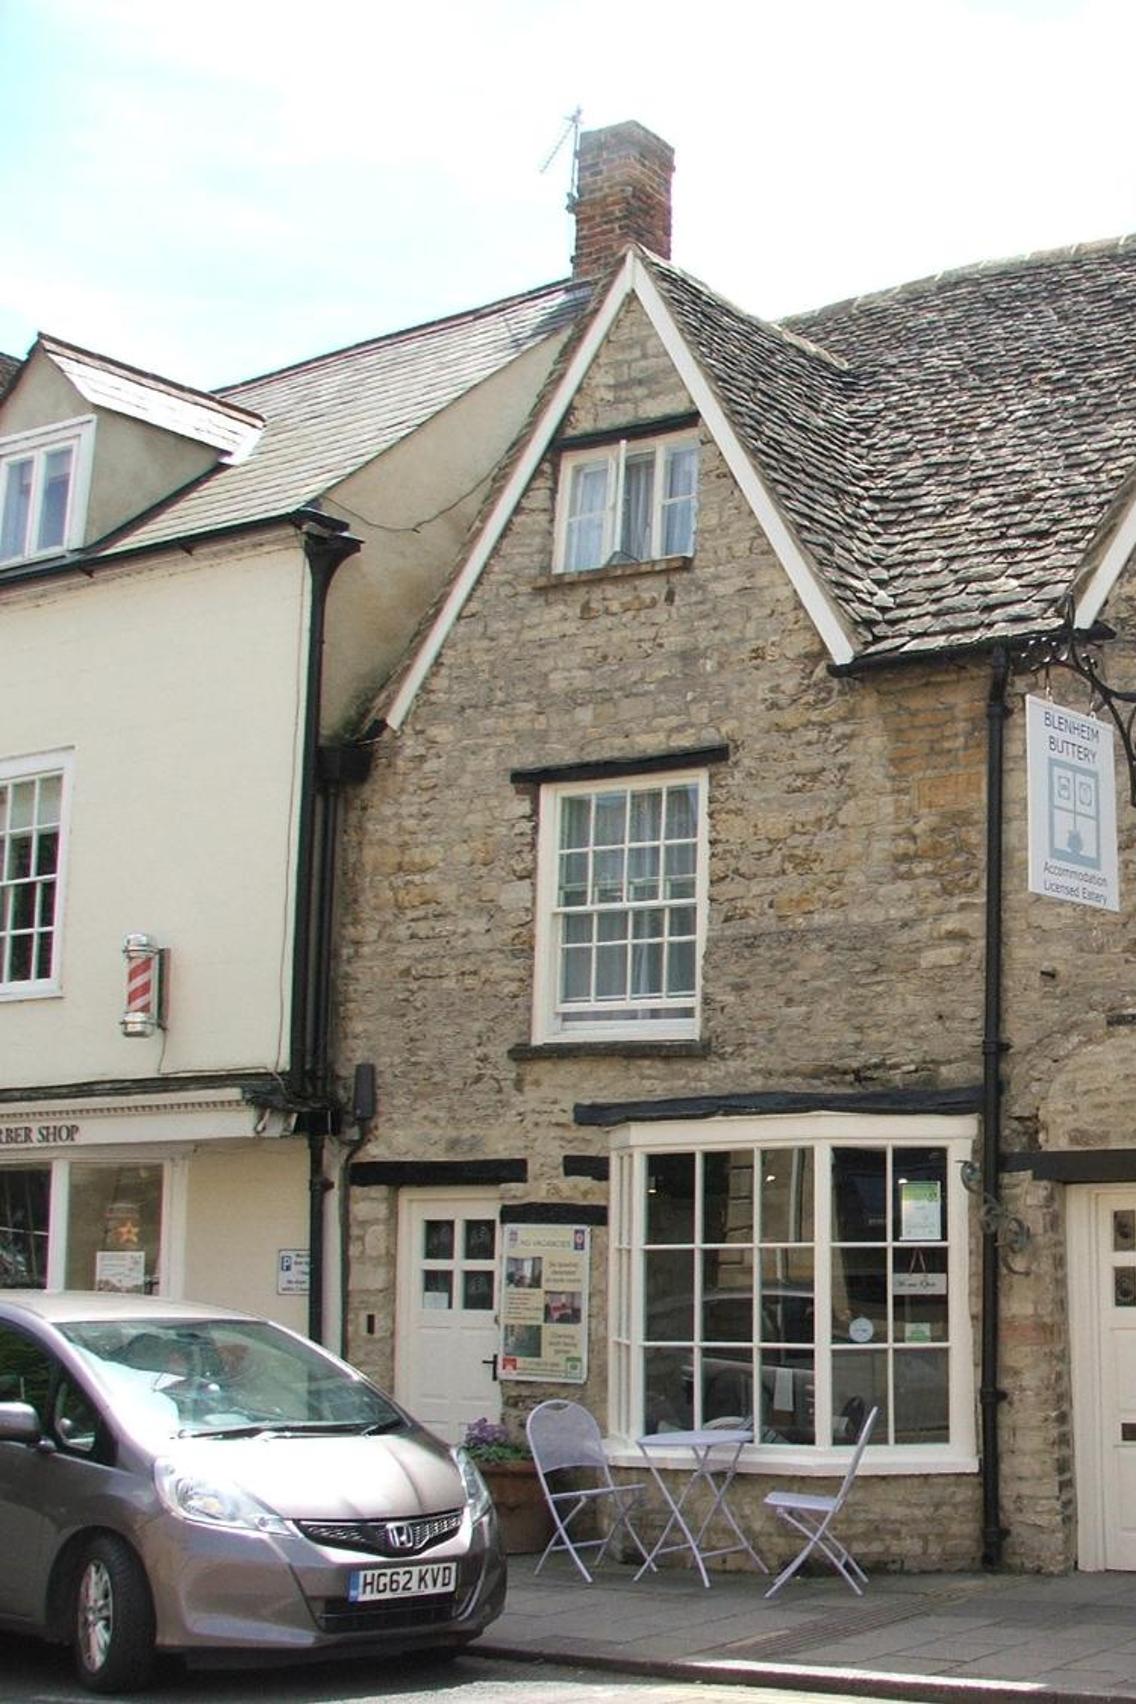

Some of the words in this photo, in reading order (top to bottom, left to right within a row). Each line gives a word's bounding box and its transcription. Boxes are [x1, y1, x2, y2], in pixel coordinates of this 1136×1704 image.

[1045, 711, 1099, 743] BLENHEIM
[1049, 735, 1097, 764] BUTTERY
[37, 1124, 79, 1143] SHOP
[363, 1570, 413, 1594] HG62
[417, 1565, 452, 1590] KVD
